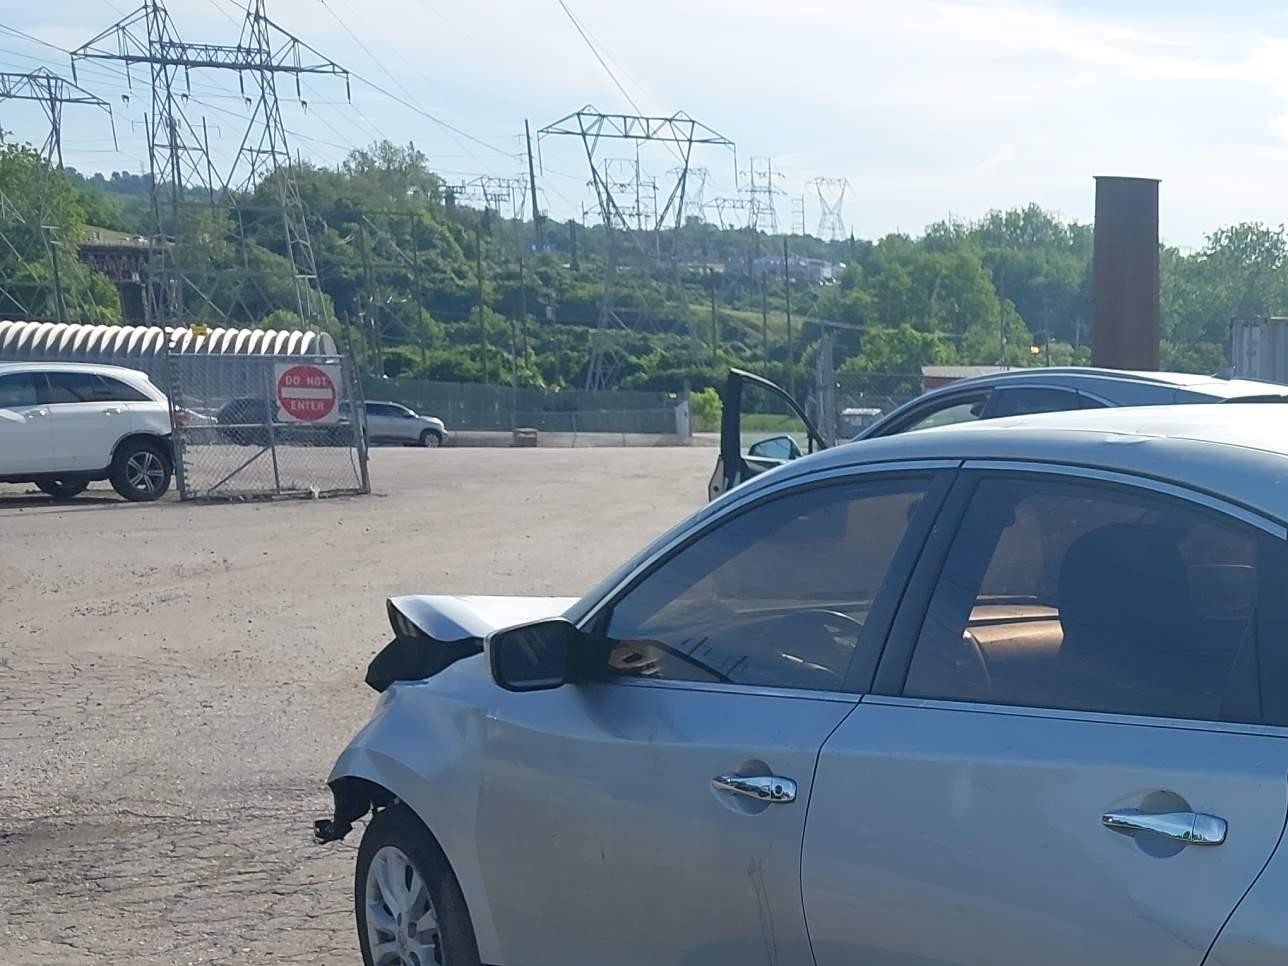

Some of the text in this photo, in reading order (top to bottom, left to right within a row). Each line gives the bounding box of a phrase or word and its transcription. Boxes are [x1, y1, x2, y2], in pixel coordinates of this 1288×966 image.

[286, 375, 327, 386] DO NOT
[291, 400, 325, 410] ENTER
